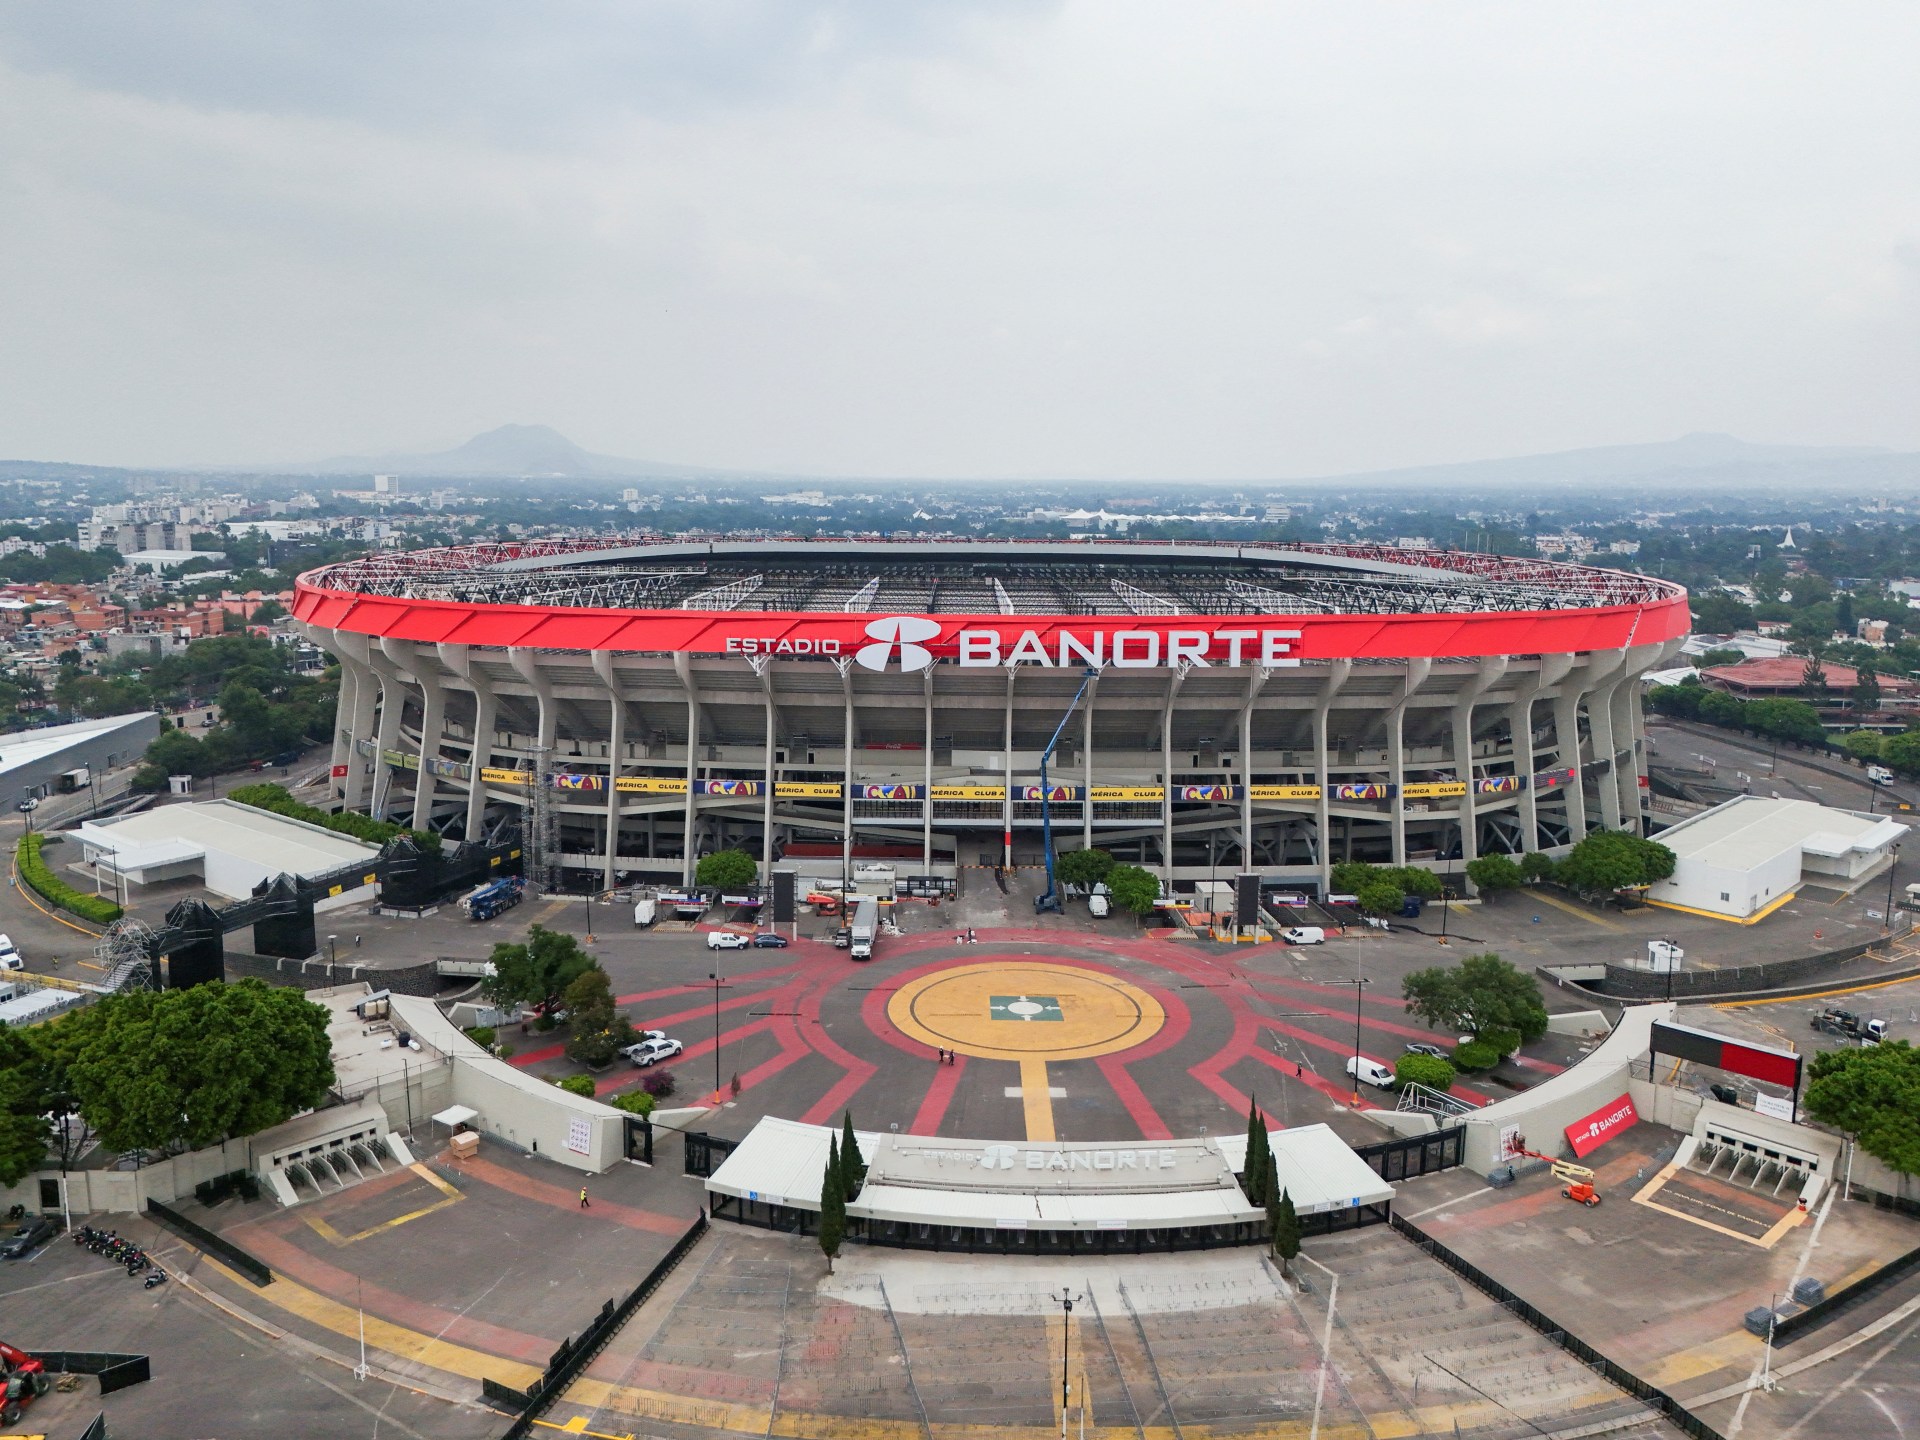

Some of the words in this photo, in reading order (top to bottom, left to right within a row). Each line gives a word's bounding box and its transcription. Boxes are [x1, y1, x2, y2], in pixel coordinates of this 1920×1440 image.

[726, 638, 840, 653] ESTADIO
[960, 630, 1302, 668] BANORTE
[481, 772, 506, 780] MÉRICA
[1599, 1105, 1632, 1131] BANORTE
[924, 1150, 974, 1161] ESTADIO
[1026, 1149, 1177, 1170] BANORTE
